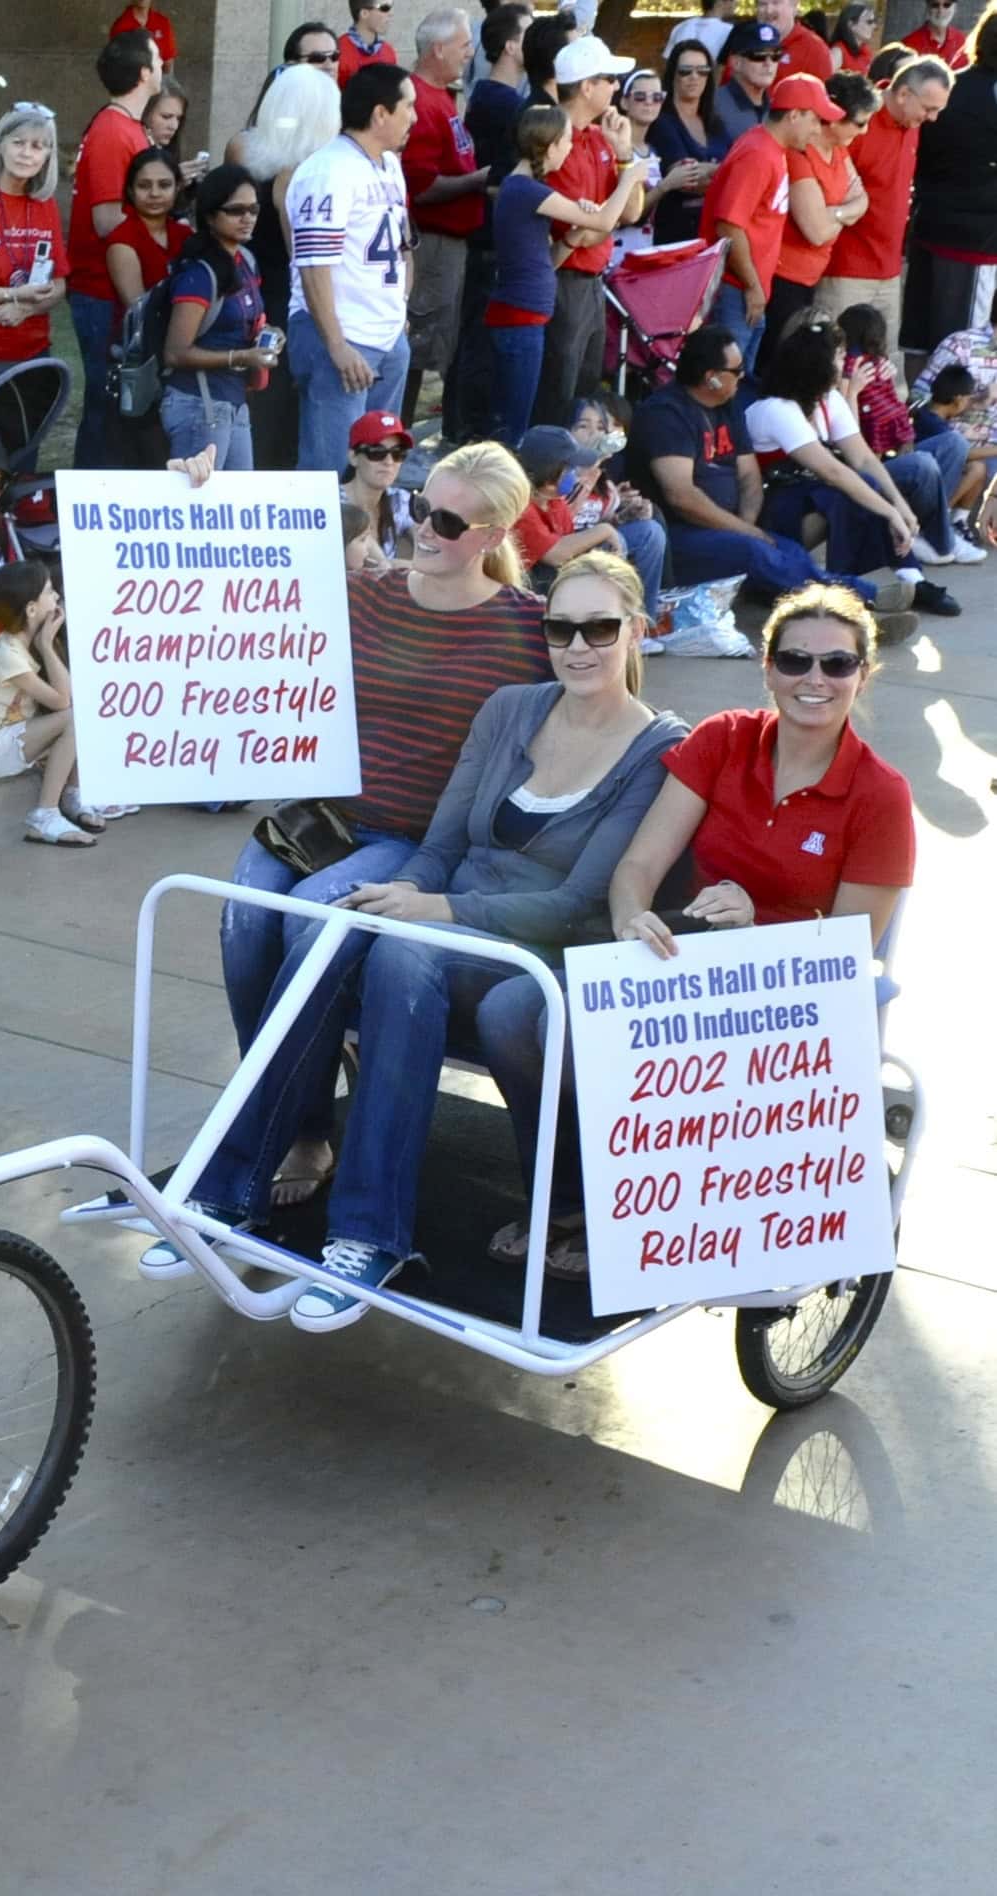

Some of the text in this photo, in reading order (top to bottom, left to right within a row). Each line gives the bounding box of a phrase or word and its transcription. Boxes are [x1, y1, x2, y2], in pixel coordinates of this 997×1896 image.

[299, 194, 333, 222] 44
[73, 504, 327, 533] UA Sports Hall of Fame
[116, 541, 292, 569] 2010 Inductees
[112, 579, 302, 615] 2002 NCAA
[91, 623, 327, 669] Championship
[98, 677, 337, 722] 800 Freestyle
[124, 729, 319, 776] Relay Team
[582, 955, 857, 1012] UA Sports Hall of Fame
[629, 1002, 819, 1050] 2010 Inductees
[629, 1037, 833, 1103] 2002 NCAA
[608, 1085, 861, 1158] Championship
[612, 1145, 866, 1221] 800 Freestyle
[639, 1210, 847, 1272] Relay Team
